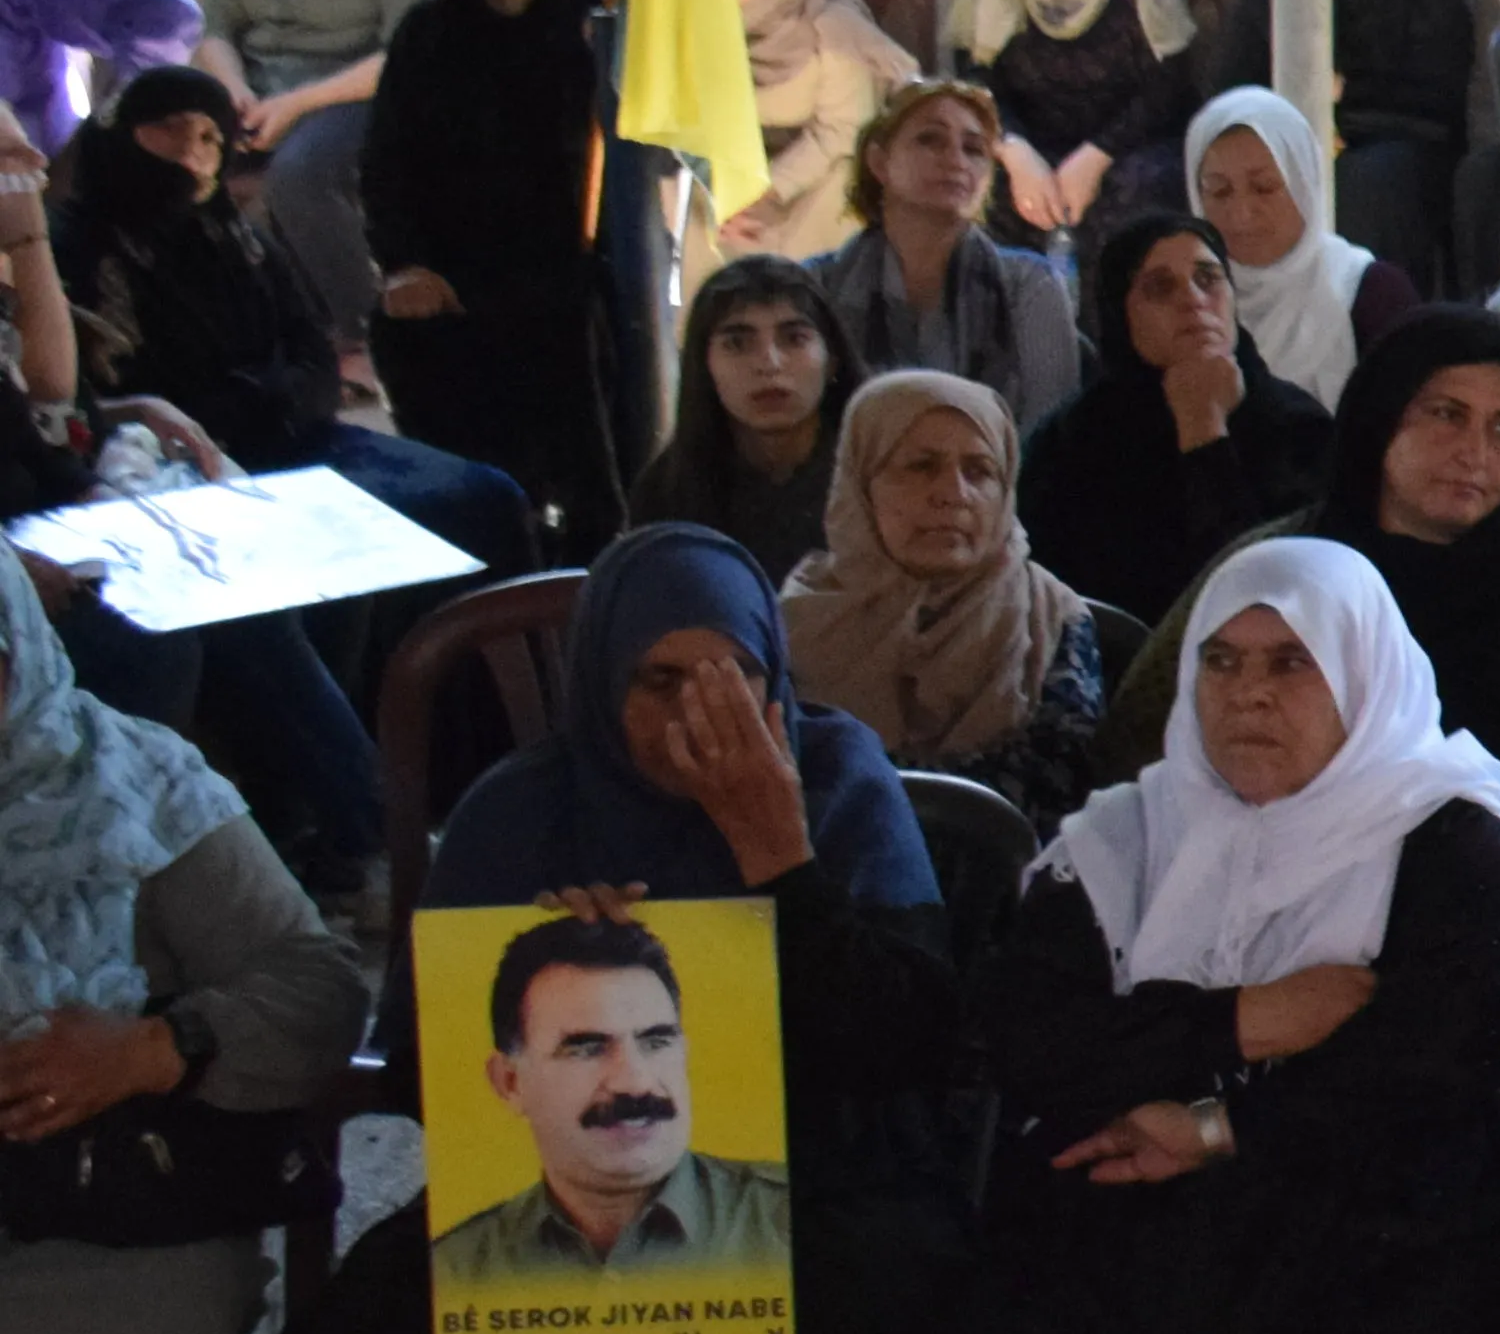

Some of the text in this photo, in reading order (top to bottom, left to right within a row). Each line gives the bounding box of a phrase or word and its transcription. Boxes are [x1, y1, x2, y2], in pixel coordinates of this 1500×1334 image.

[443, 1298, 787, 1334] BÊ SEROK JIYAN NABE
